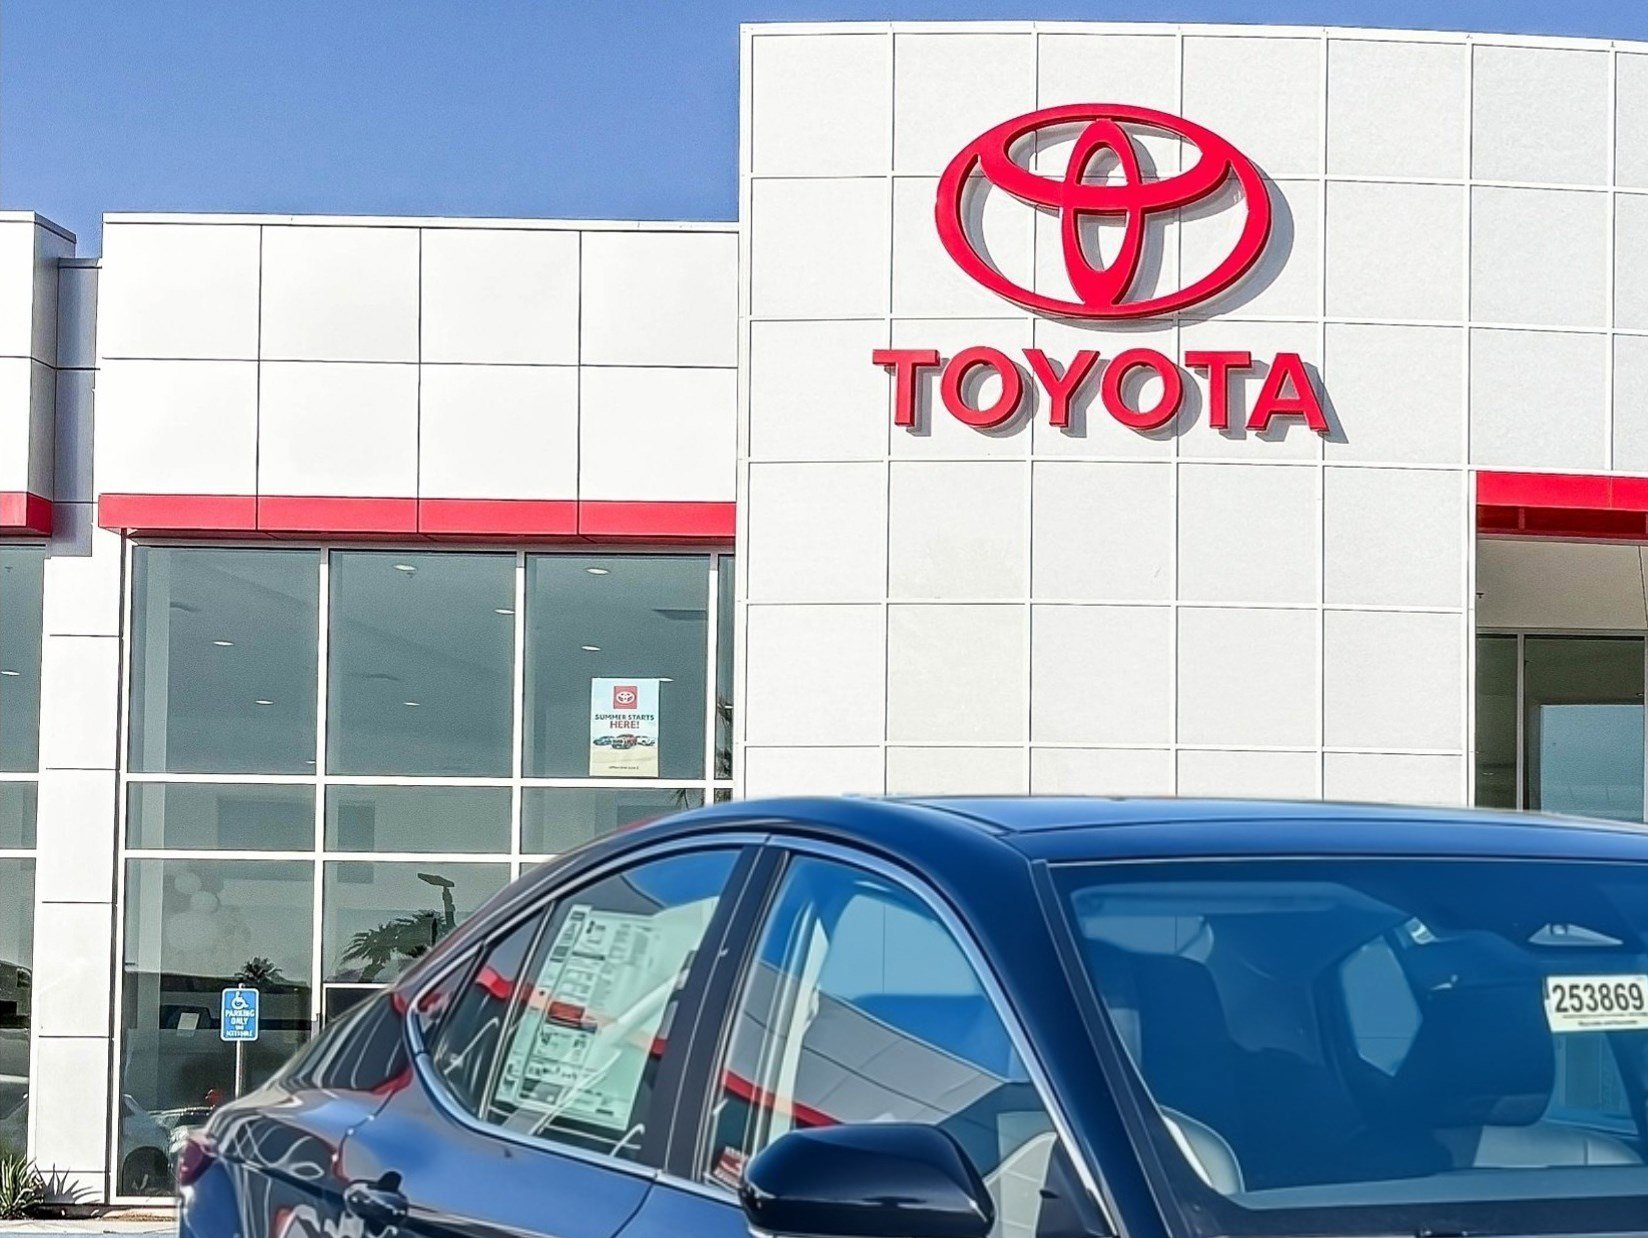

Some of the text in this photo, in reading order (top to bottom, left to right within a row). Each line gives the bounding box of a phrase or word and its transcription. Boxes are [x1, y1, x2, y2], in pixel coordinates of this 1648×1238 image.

[872, 346, 1330, 432] TOYOTA
[609, 721, 640, 729] HERE!
[1552, 983, 1645, 1013] 253869
[225, 1009, 255, 1017] PARKING
[231, 1017, 249, 1025] ONLY
